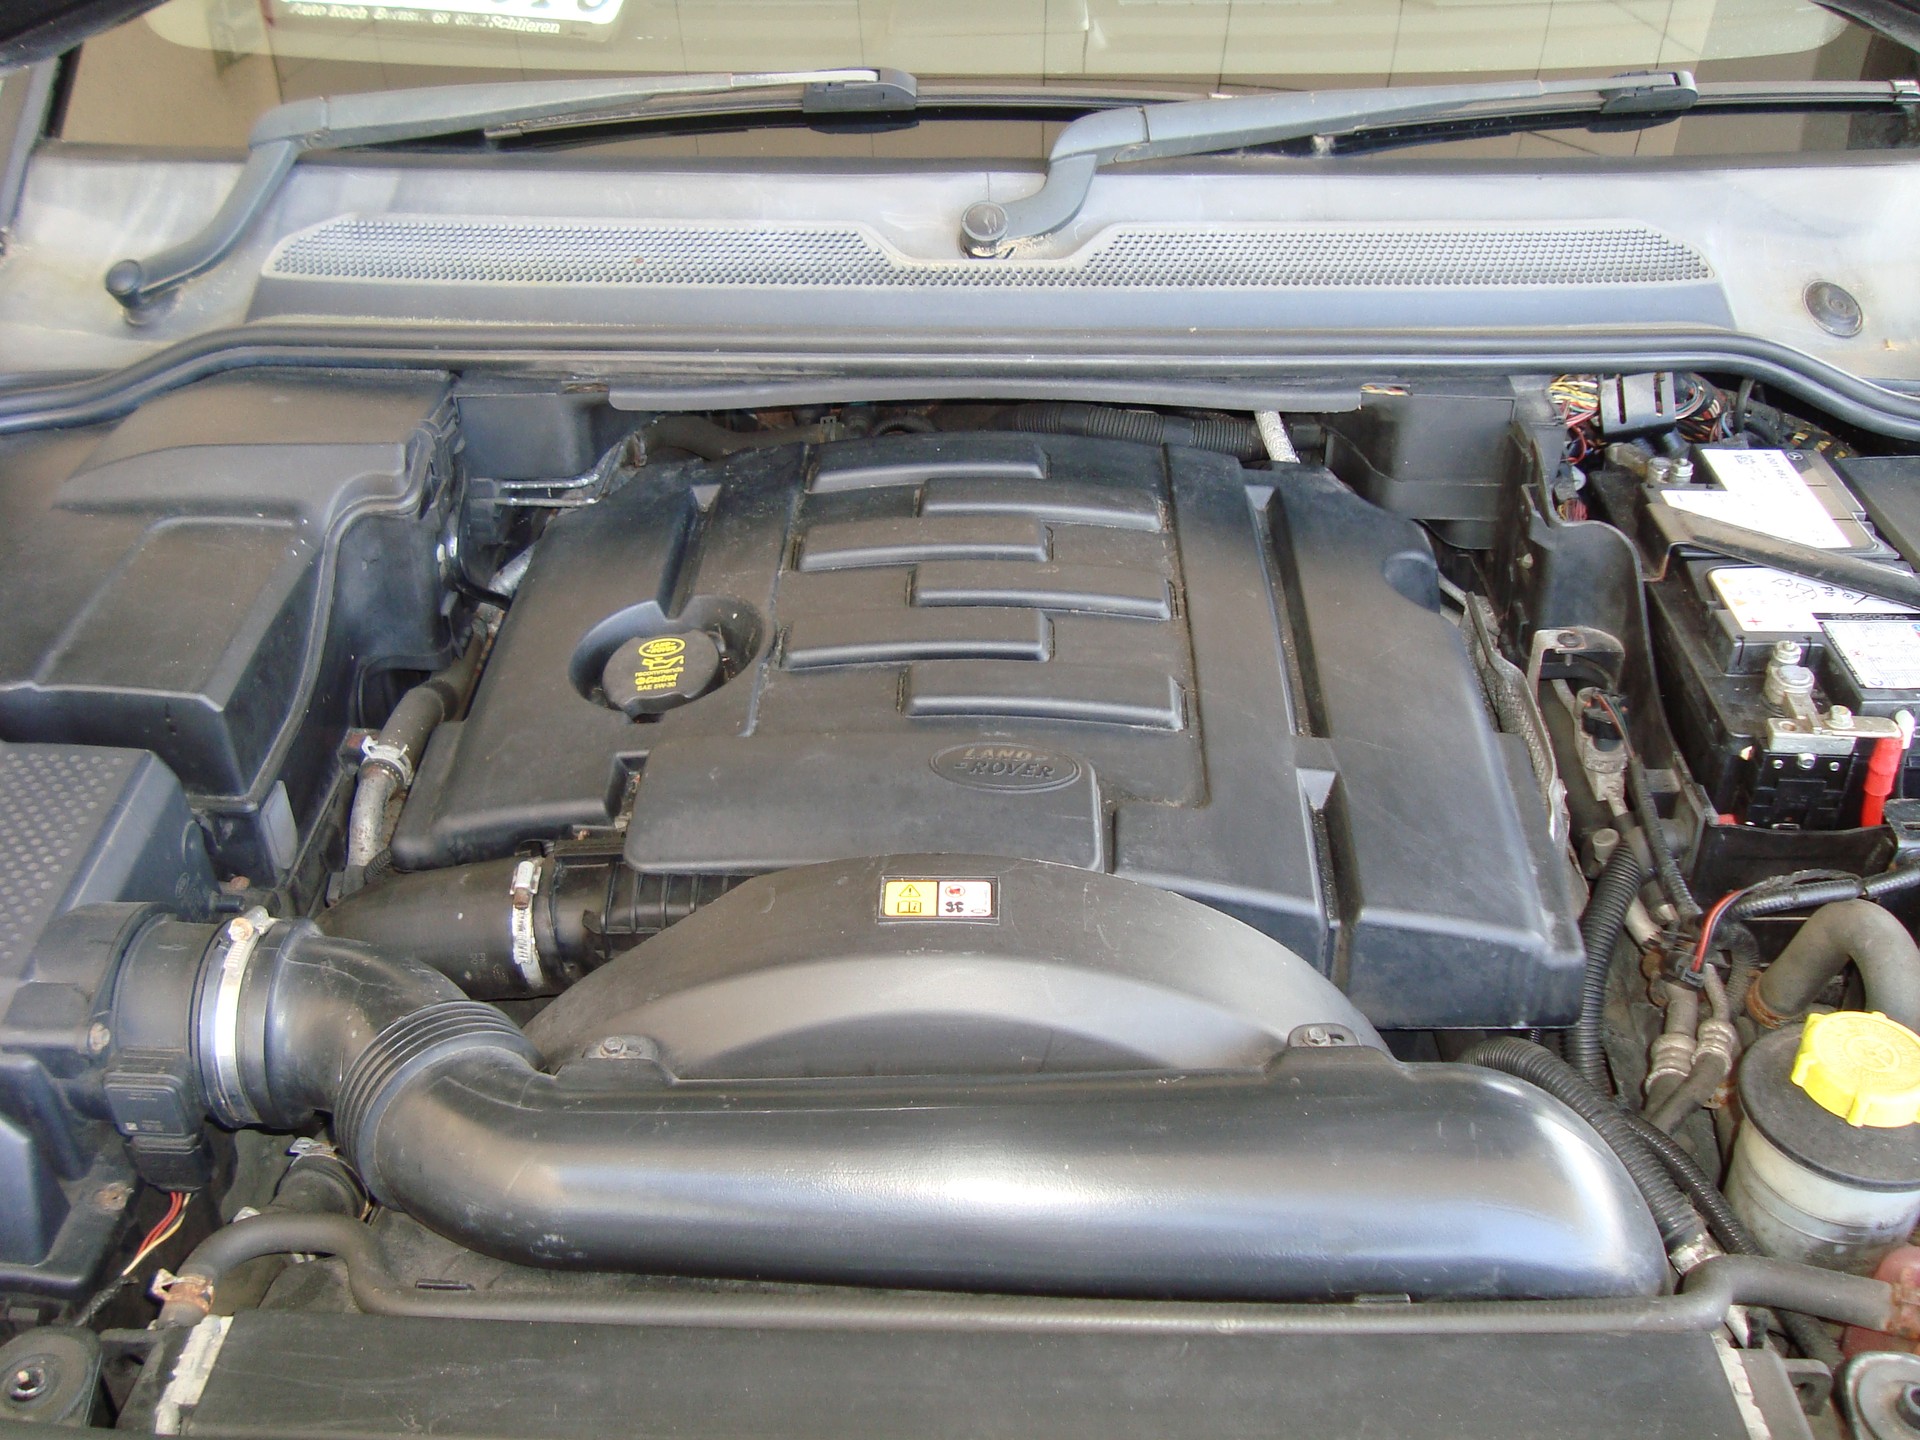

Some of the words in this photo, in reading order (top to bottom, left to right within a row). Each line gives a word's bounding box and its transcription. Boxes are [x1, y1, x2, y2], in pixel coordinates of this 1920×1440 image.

[289, 2, 327, 16] Auto
[328, 4, 368, 20] Koch
[489, 15, 560, 34] Schlieren
[635, 666, 684, 678] recommends
[645, 673, 679, 684] Castrol
[654, 681, 677, 689] 5W-30
[963, 748, 1033, 762] LAND
[969, 760, 1056, 780] ROVER
